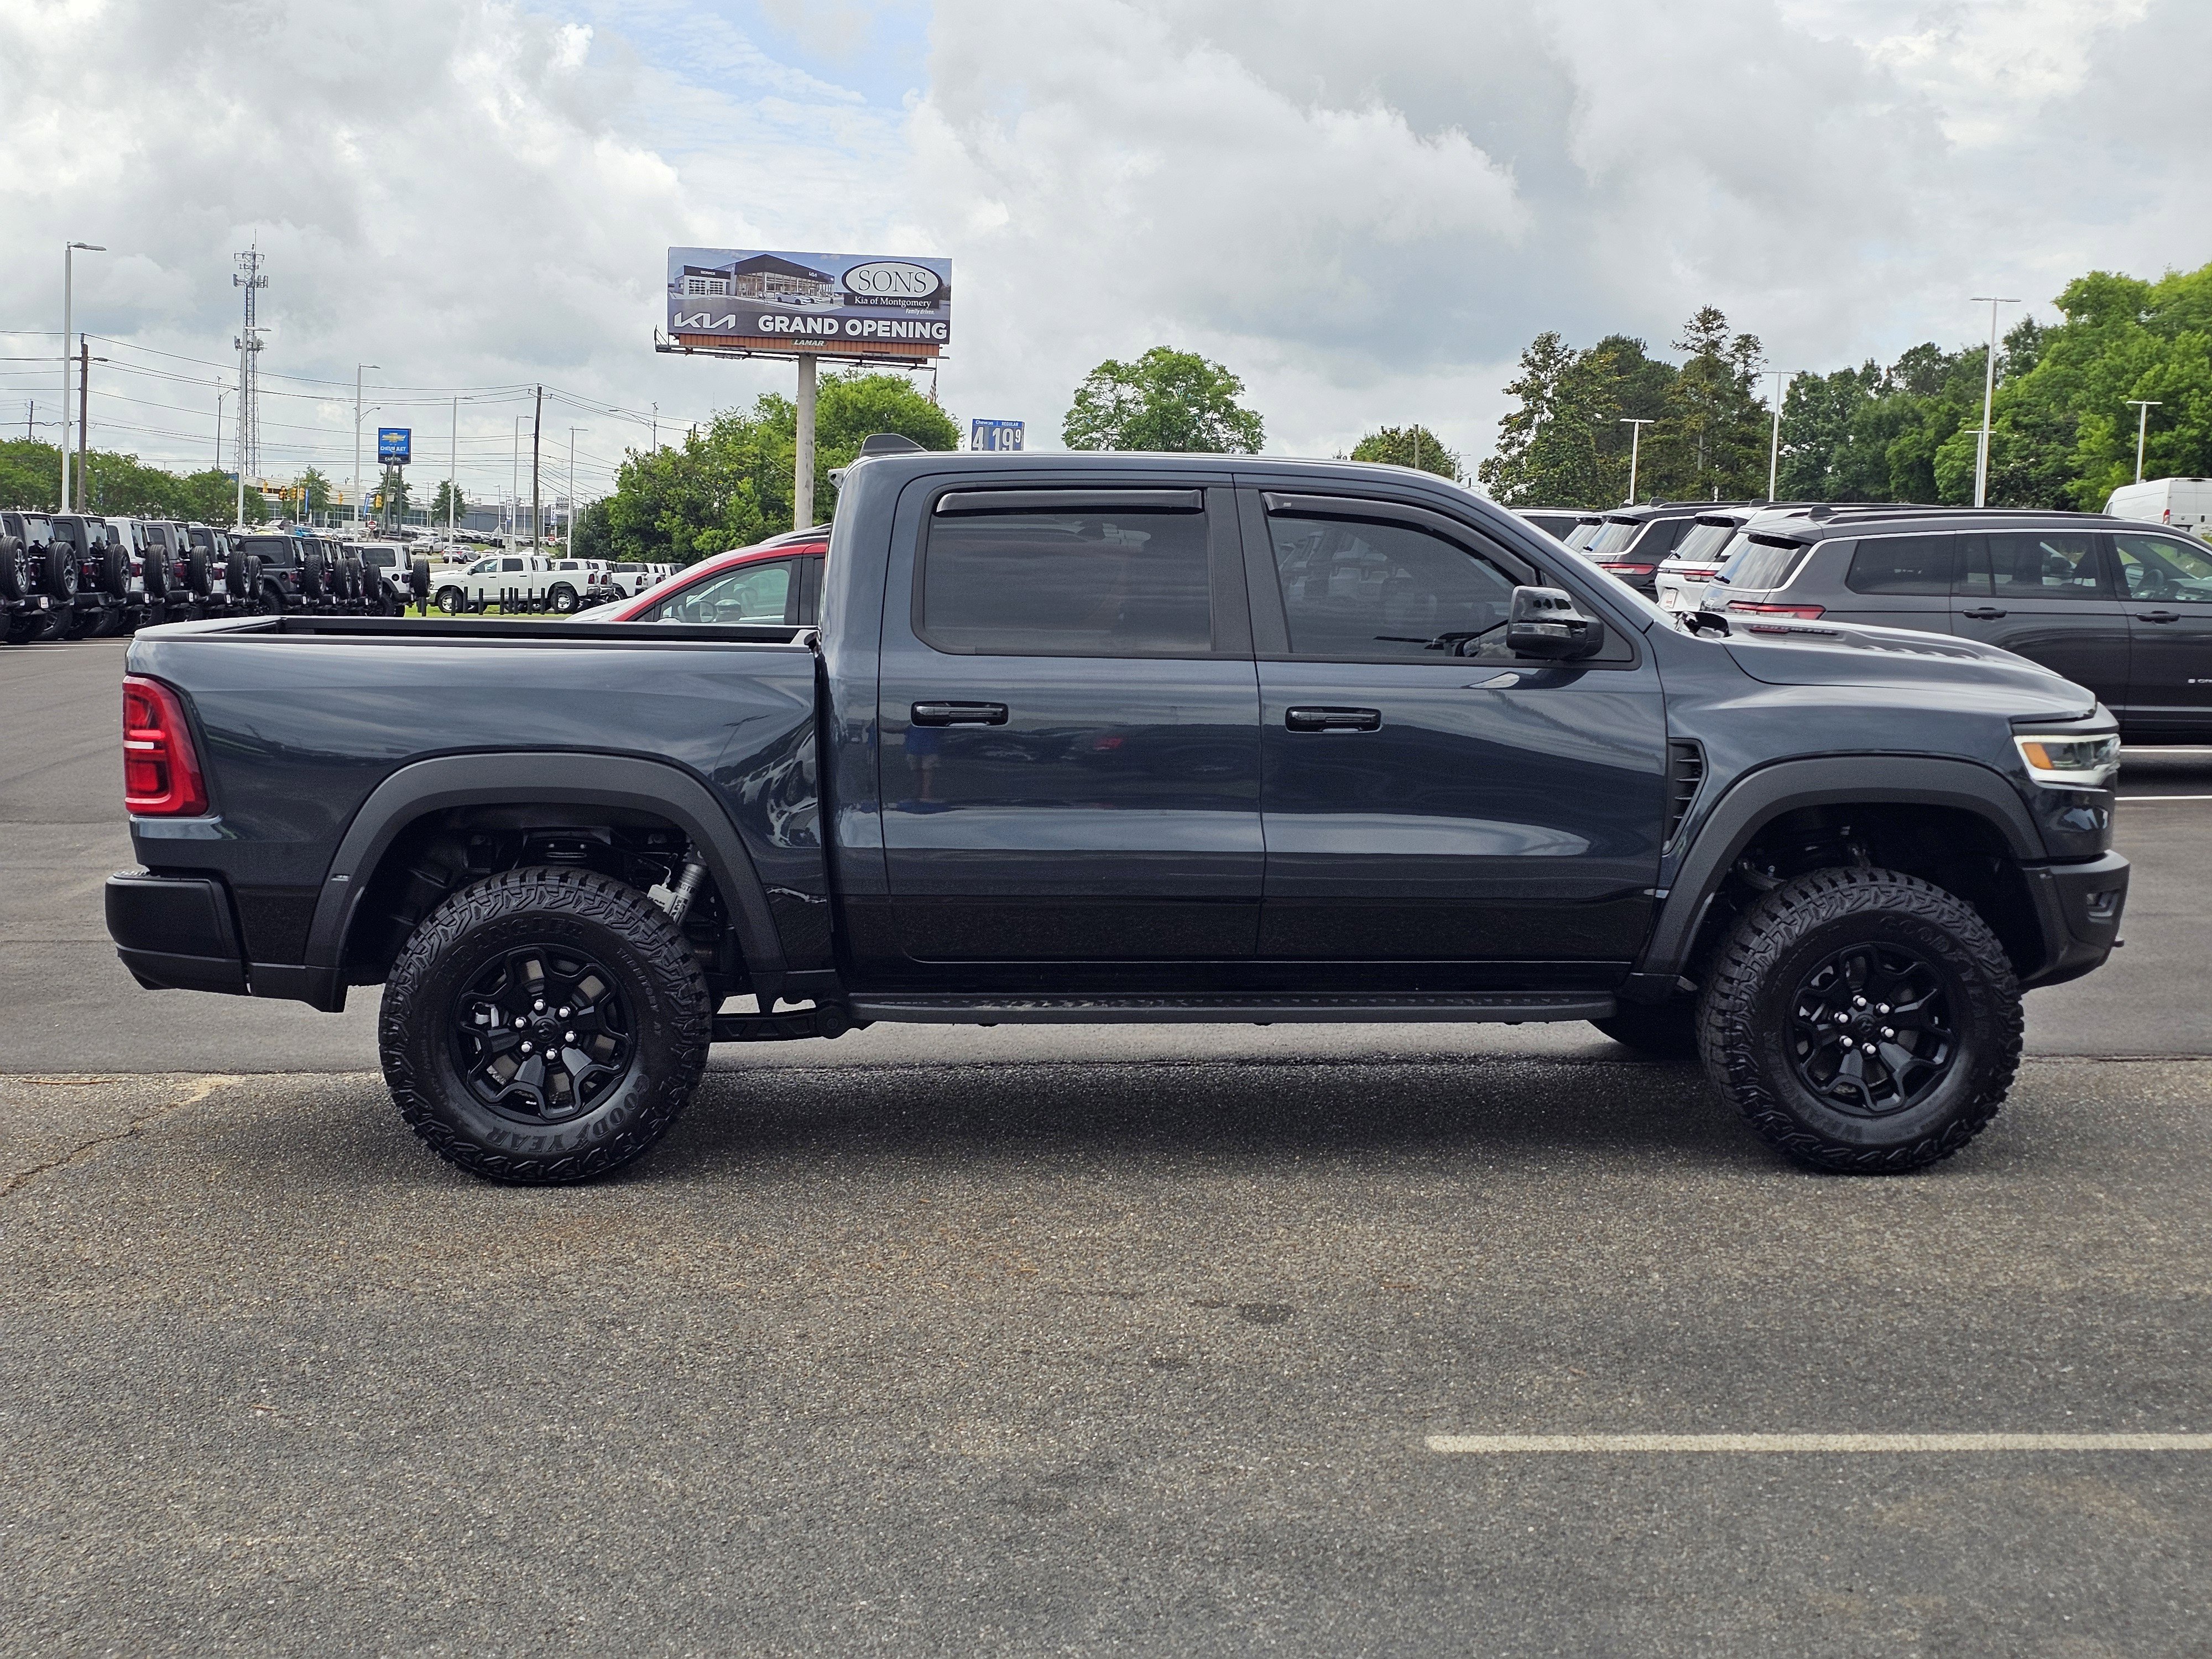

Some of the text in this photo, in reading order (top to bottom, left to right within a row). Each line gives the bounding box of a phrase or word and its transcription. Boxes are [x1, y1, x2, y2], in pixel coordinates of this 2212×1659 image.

[858, 269, 926, 293] SONS
[854, 296, 868, 304] Kia
[880, 298, 931, 309] Montgomery
[674, 311, 736, 330] KIA
[758, 315, 947, 340] GRAND OPENING
[486, 1073, 650, 1152] GOODYEAR
